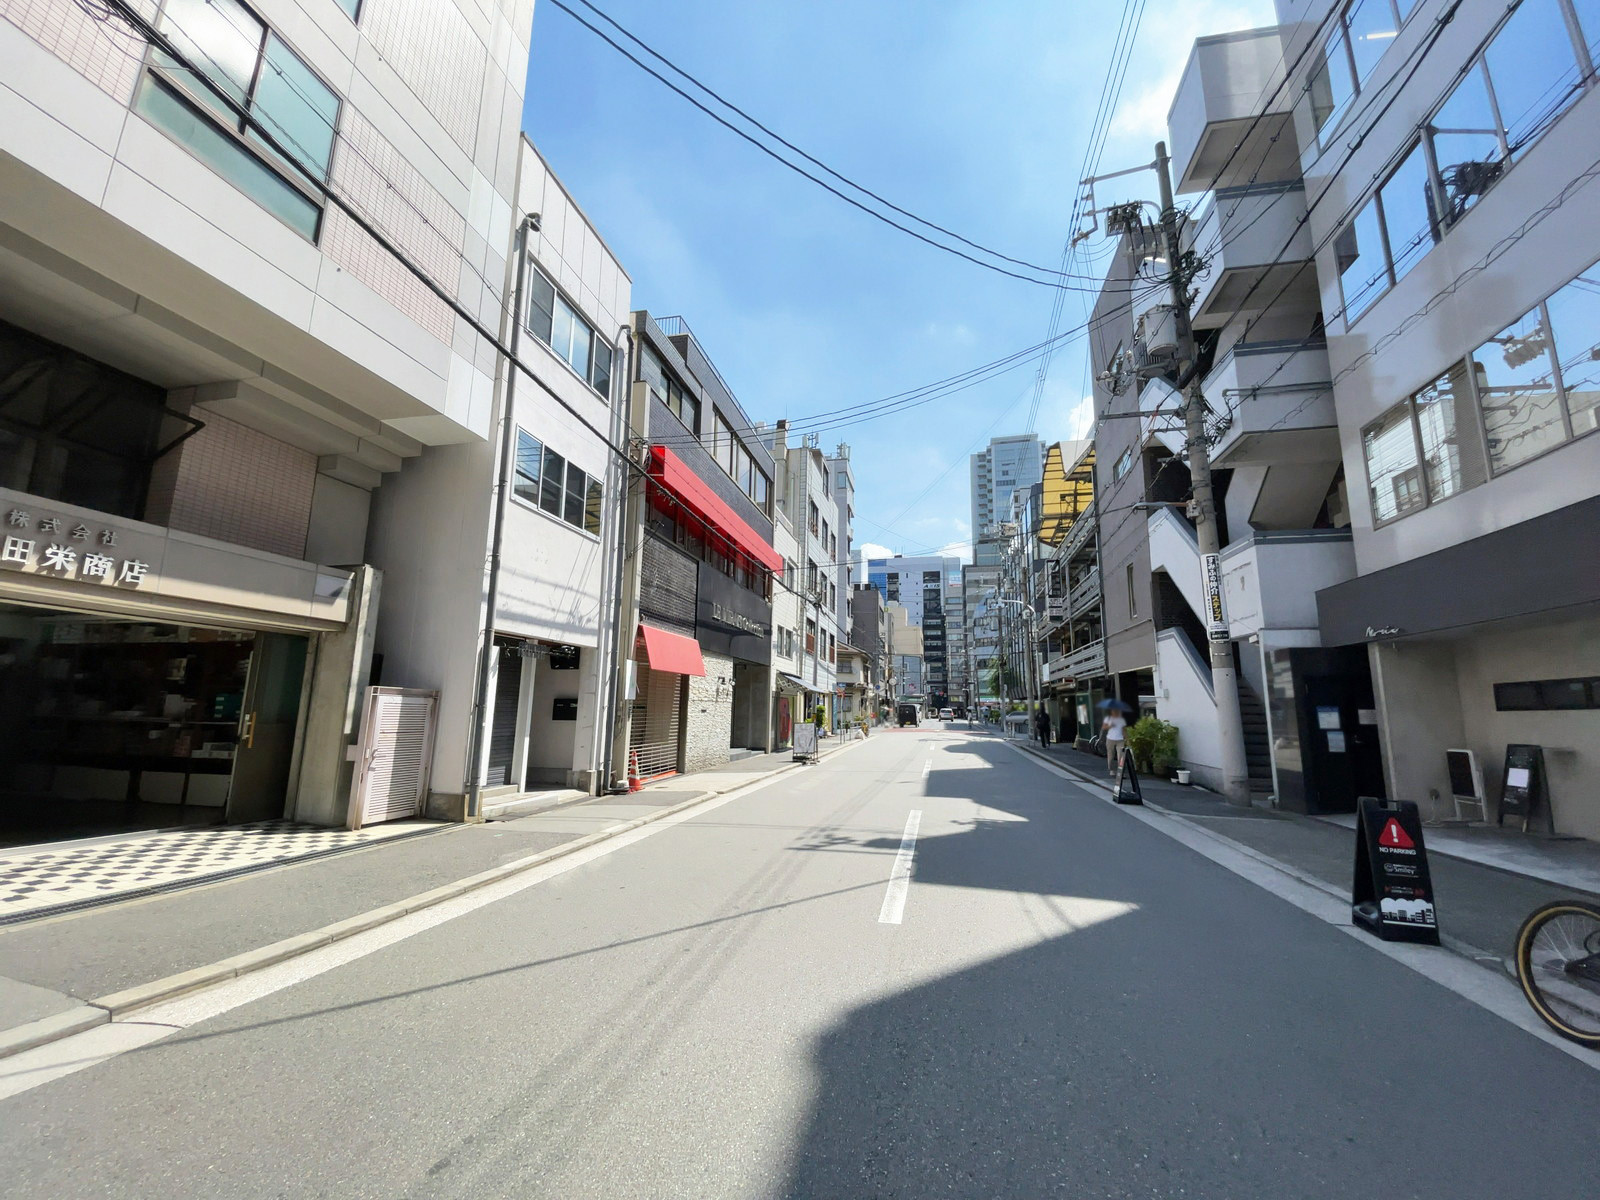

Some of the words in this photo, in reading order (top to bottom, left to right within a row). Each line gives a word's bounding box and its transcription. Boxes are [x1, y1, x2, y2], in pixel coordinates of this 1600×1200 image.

[9, 508, 118, 547] 株式会社
[1, 535, 150, 585] 田栄商店
[1389, 847, 1417, 855] PARKING
